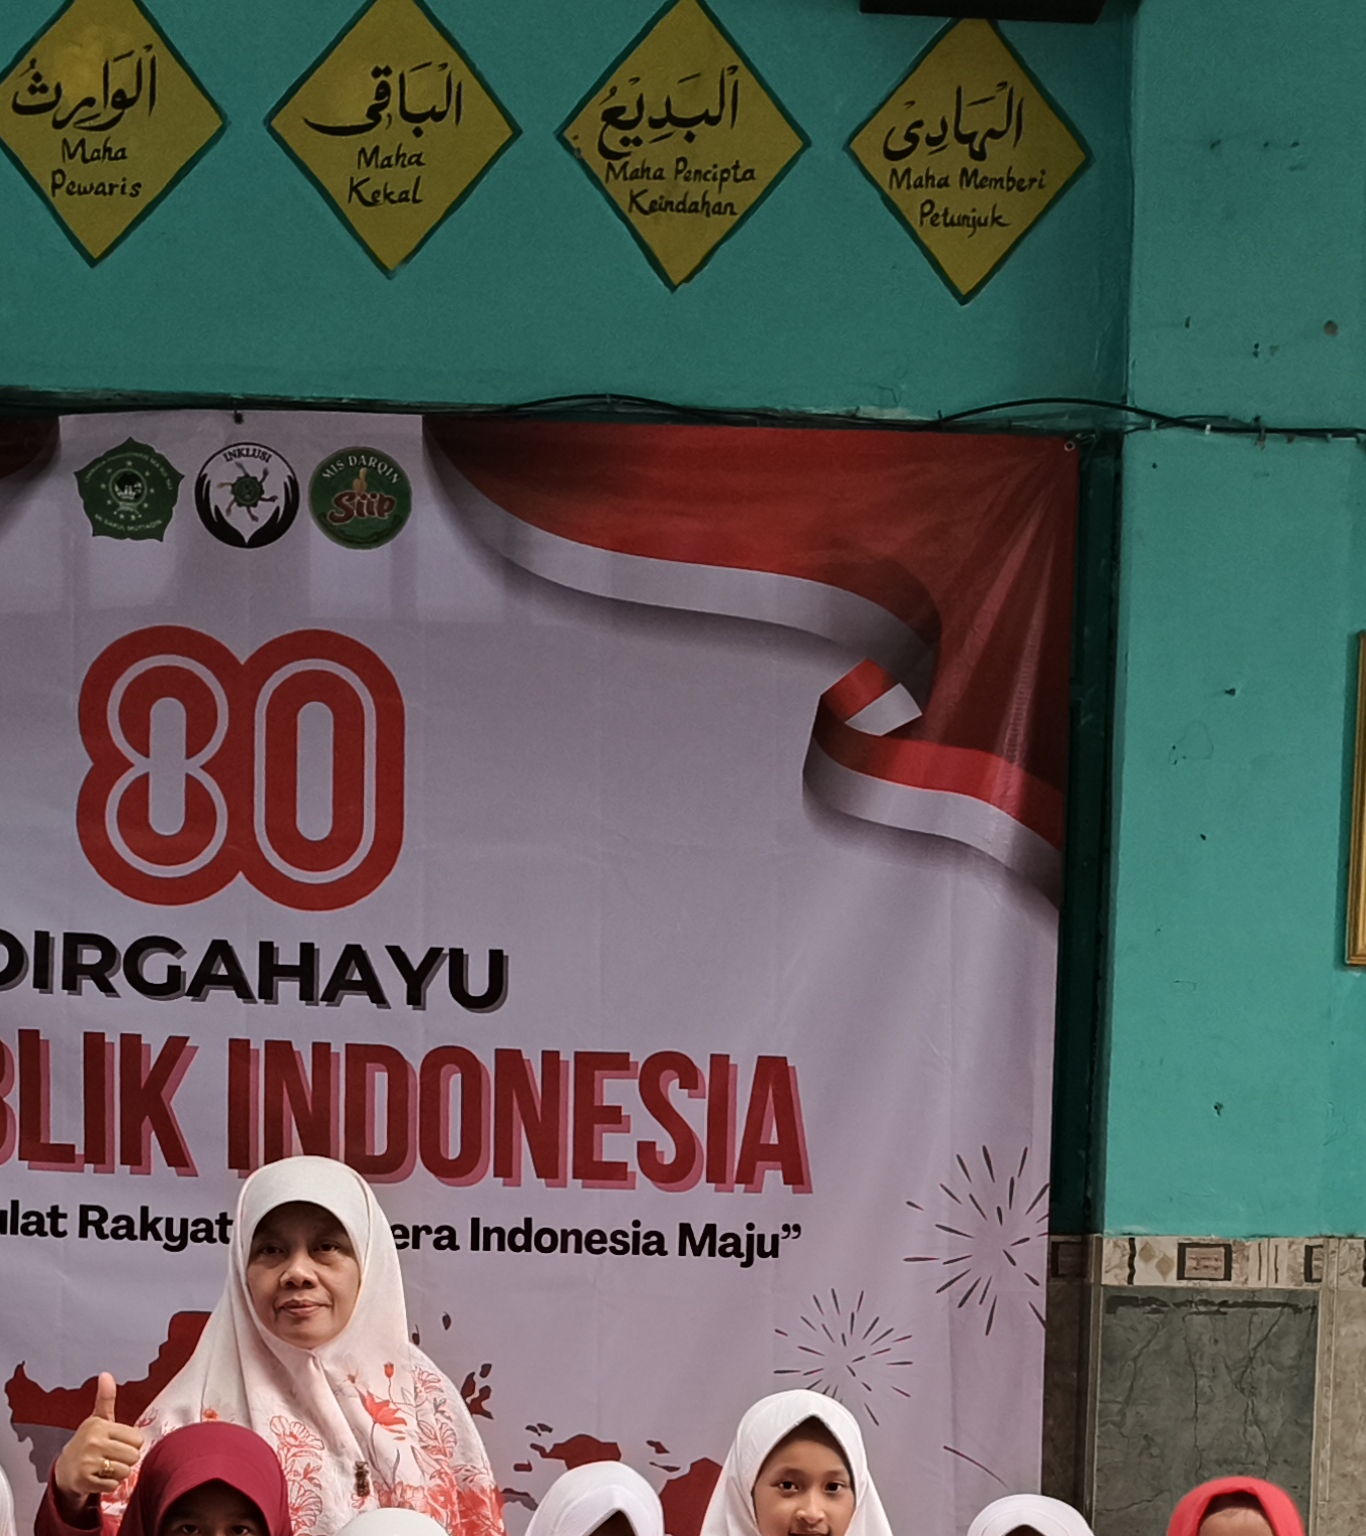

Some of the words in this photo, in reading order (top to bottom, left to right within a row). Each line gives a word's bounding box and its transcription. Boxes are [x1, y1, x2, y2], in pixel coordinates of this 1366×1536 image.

[62, 137, 127, 163] Maha
[357, 143, 426, 170] Maha
[51, 169, 142, 198] Pewaris
[605, 158, 665, 183] Maha
[674, 157, 756, 194] Pencipta
[888, 167, 950, 191] Maha
[959, 166, 1046, 192] Memberi
[348, 175, 423, 207] Kekal
[628, 189, 738, 218] Keindahan
[919, 199, 1012, 238] Petunjuk
[222, 448, 272, 463] INKLUSI
[322, 459, 345, 481] MIS
[348, 455, 401, 484] DARQIN
[76, 624, 406, 912] 80
[227, 1037, 813, 1194] INDONESIA
[78, 1203, 234, 1252] Rakyat
[470, 1217, 667, 1257] Indonesia
